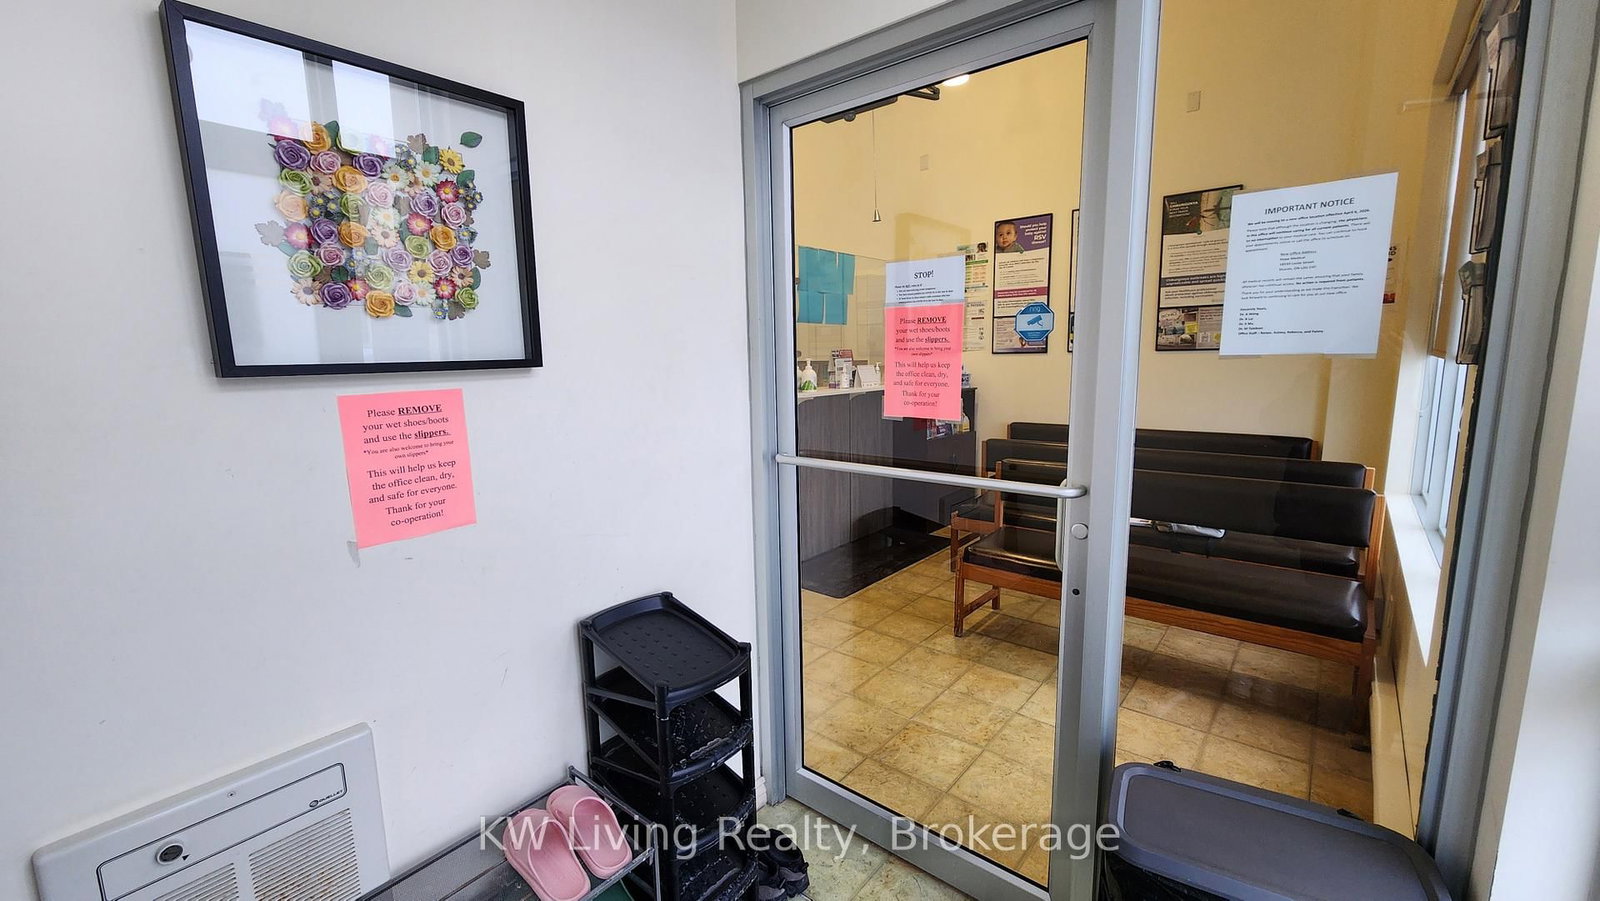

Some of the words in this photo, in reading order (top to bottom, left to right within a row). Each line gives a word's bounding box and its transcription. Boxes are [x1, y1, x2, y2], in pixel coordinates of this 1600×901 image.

[1264, 202, 1318, 214] IMPORTANT
[1320, 198, 1355, 208] NOTICE
[914, 270, 934, 279] STOP!
[917, 316, 946, 324] REMOVE
[367, 409, 396, 417] Please
[398, 404, 442, 416] REMOVE
[362, 423, 383, 433] your
[403, 416, 449, 427] shoes/boots
[363, 435, 380, 444] and
[399, 432, 412, 440] the
[367, 470, 387, 478] This
[390, 466, 405, 474] will
[408, 464, 425, 473] help
[438, 460, 456, 468] keep
[372, 482, 386, 490] the
[388, 478, 413, 488] office
[414, 475, 438, 483] clean,
[440, 472, 455, 480] dry,
[368, 494, 385, 504] and
[387, 491, 404, 500] safe
[407, 489, 419, 497] for
[420, 483, 457, 495] everyone.
[385, 504, 413, 514] Thank
[415, 501, 427, 510] for
[428, 498, 446, 508] your
[391, 509, 444, 526] co-operation!
